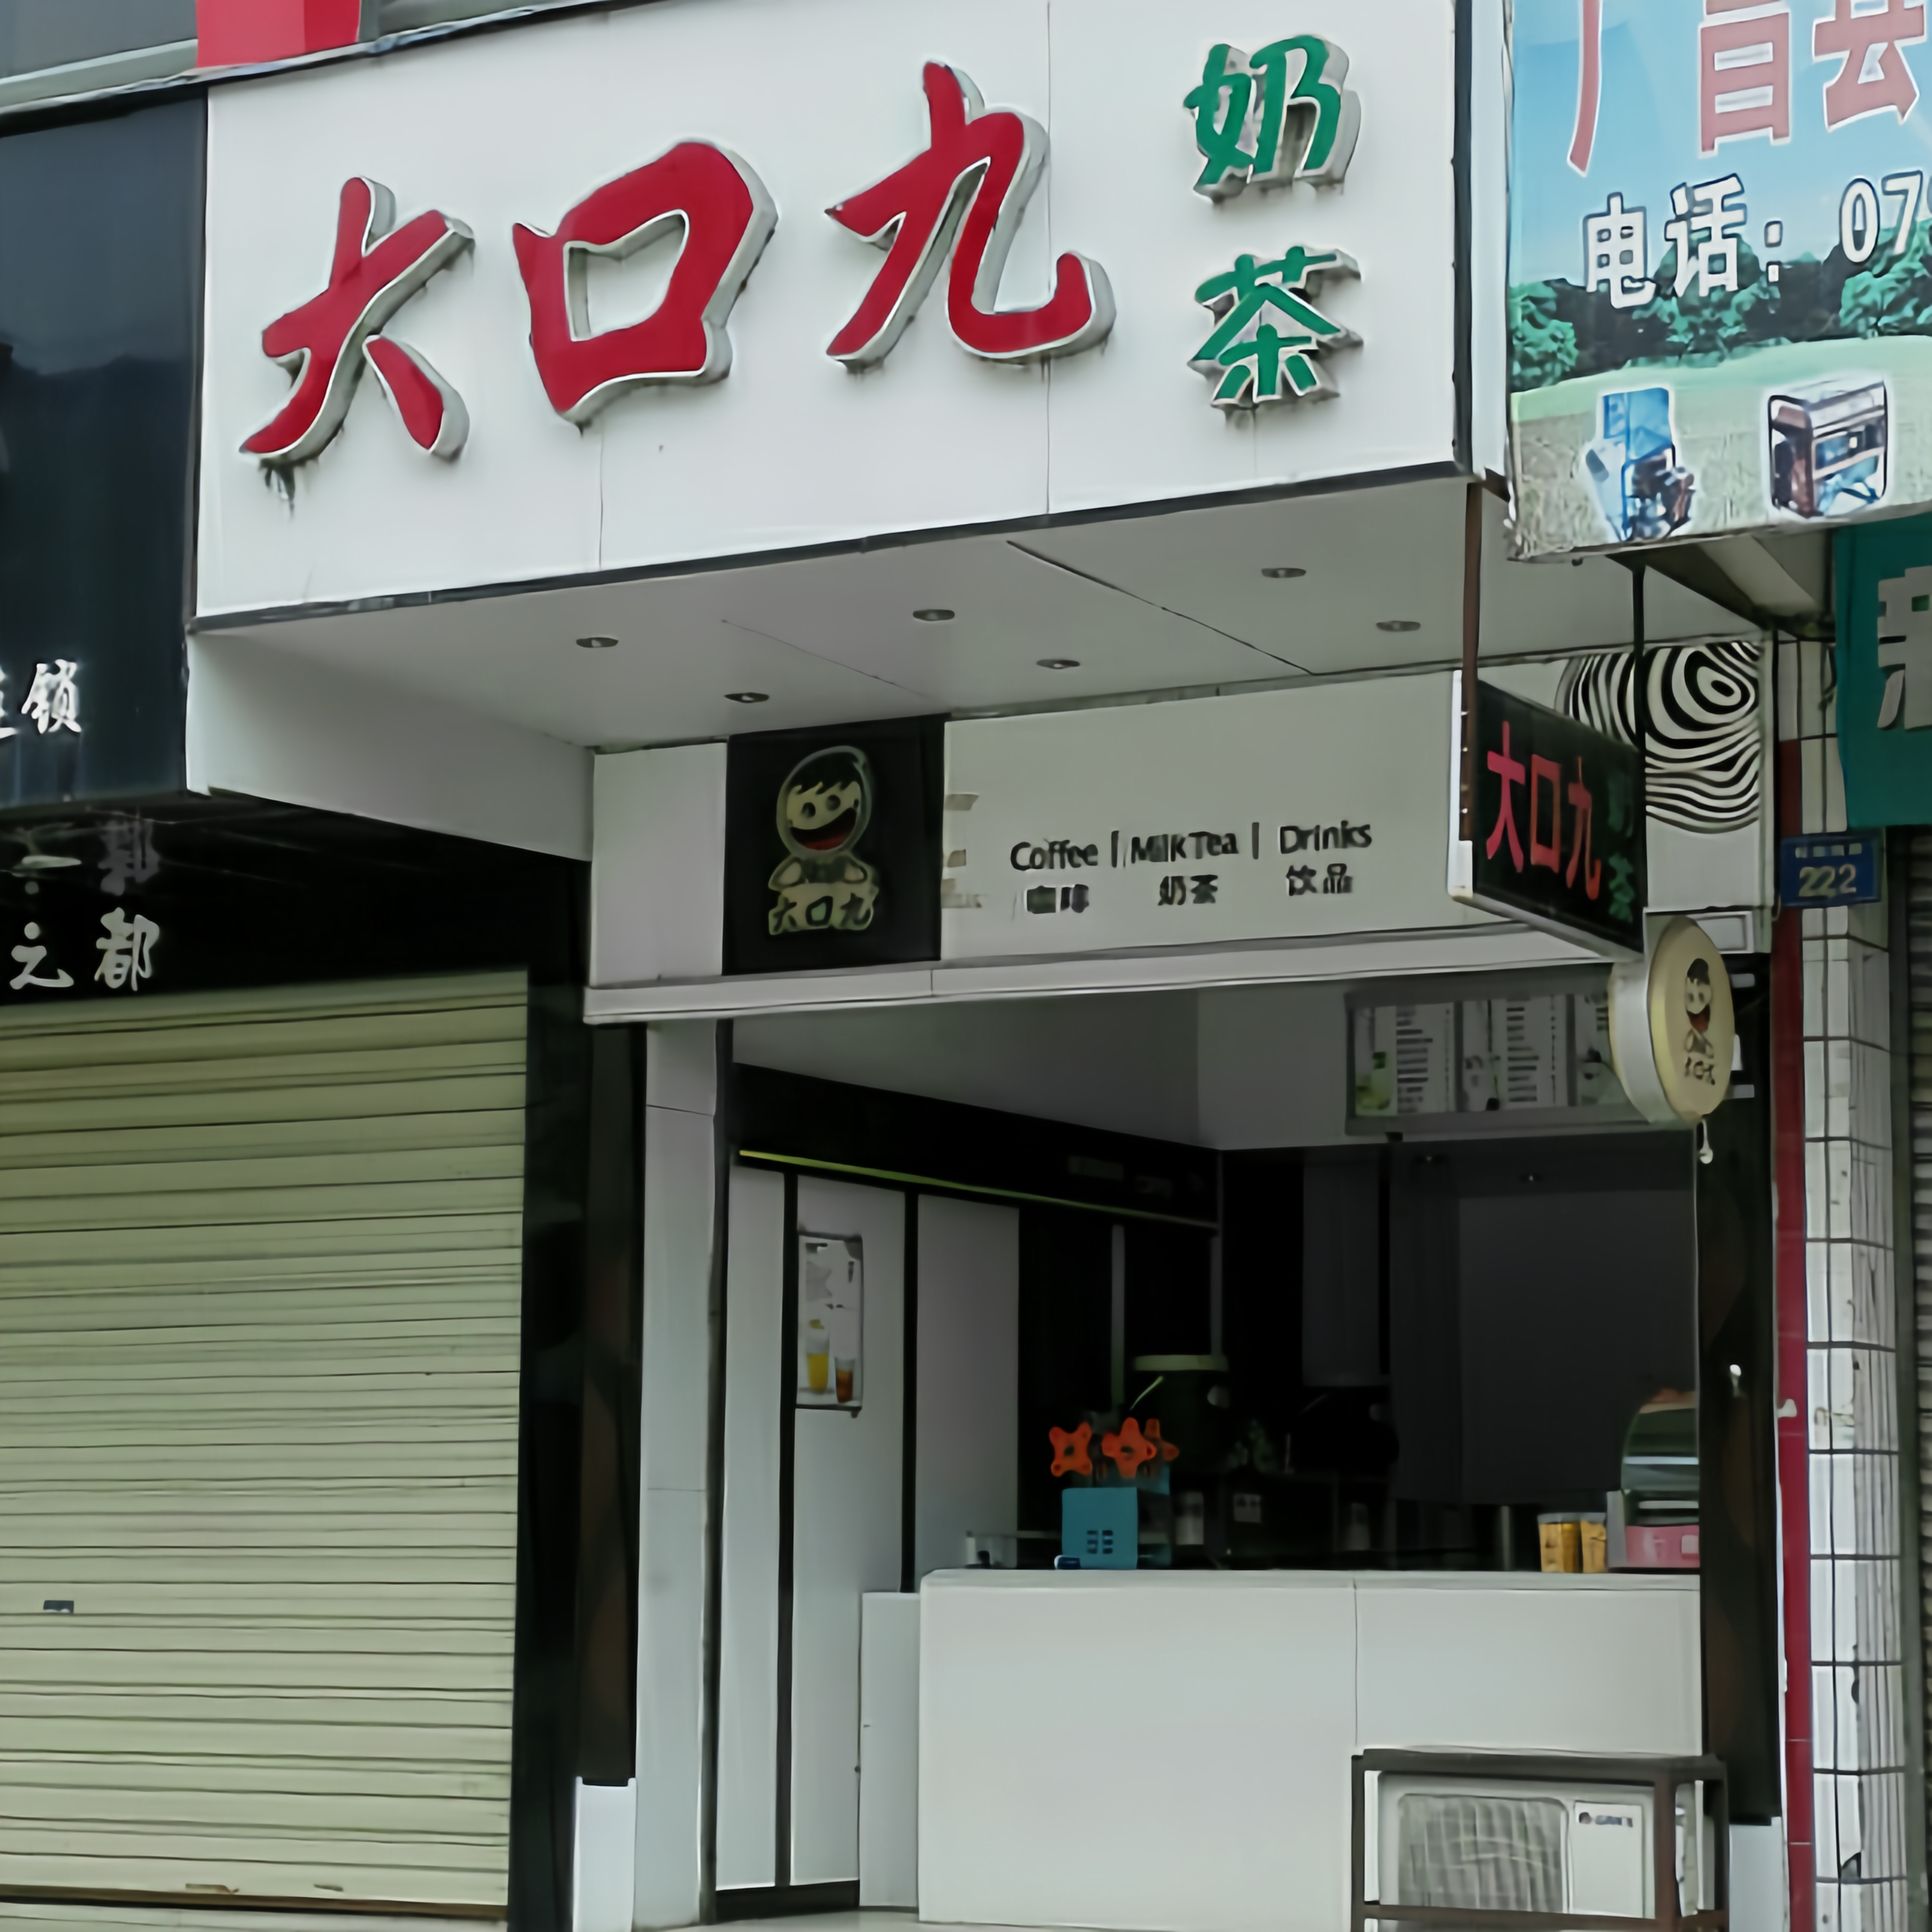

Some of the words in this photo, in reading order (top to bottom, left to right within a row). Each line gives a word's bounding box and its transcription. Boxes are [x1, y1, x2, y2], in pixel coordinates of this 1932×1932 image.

[240, 60, 1115, 462] 大口九
[1185, 35, 1361, 409] 奶茶
[1839, 169, 1932, 266] 07
[1011, 838, 1098, 871] Coffee
[1280, 820, 1372, 854] Drinks
[1486, 721, 1601, 900] 大口九
[1798, 863, 1857, 898] 222
[10, 907, 160, 992] 之都
